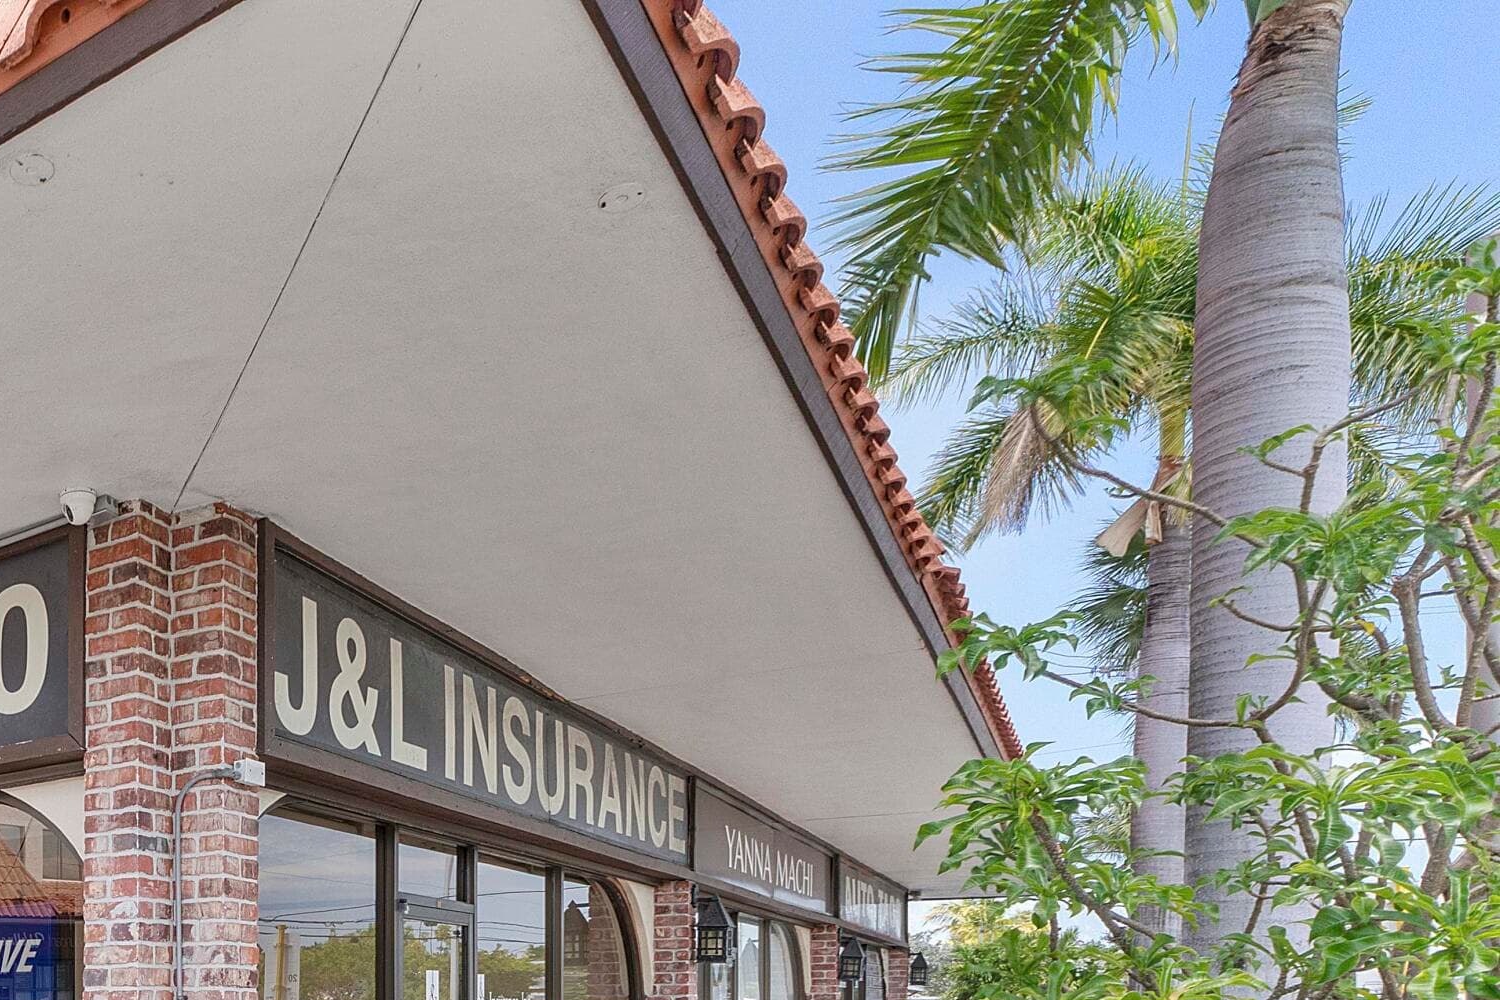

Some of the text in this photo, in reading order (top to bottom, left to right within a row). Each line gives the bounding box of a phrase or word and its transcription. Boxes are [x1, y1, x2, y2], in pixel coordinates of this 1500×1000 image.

[274, 596, 686, 854] J&L INSURANCE
[725, 825, 814, 897] YANNA MACHI
